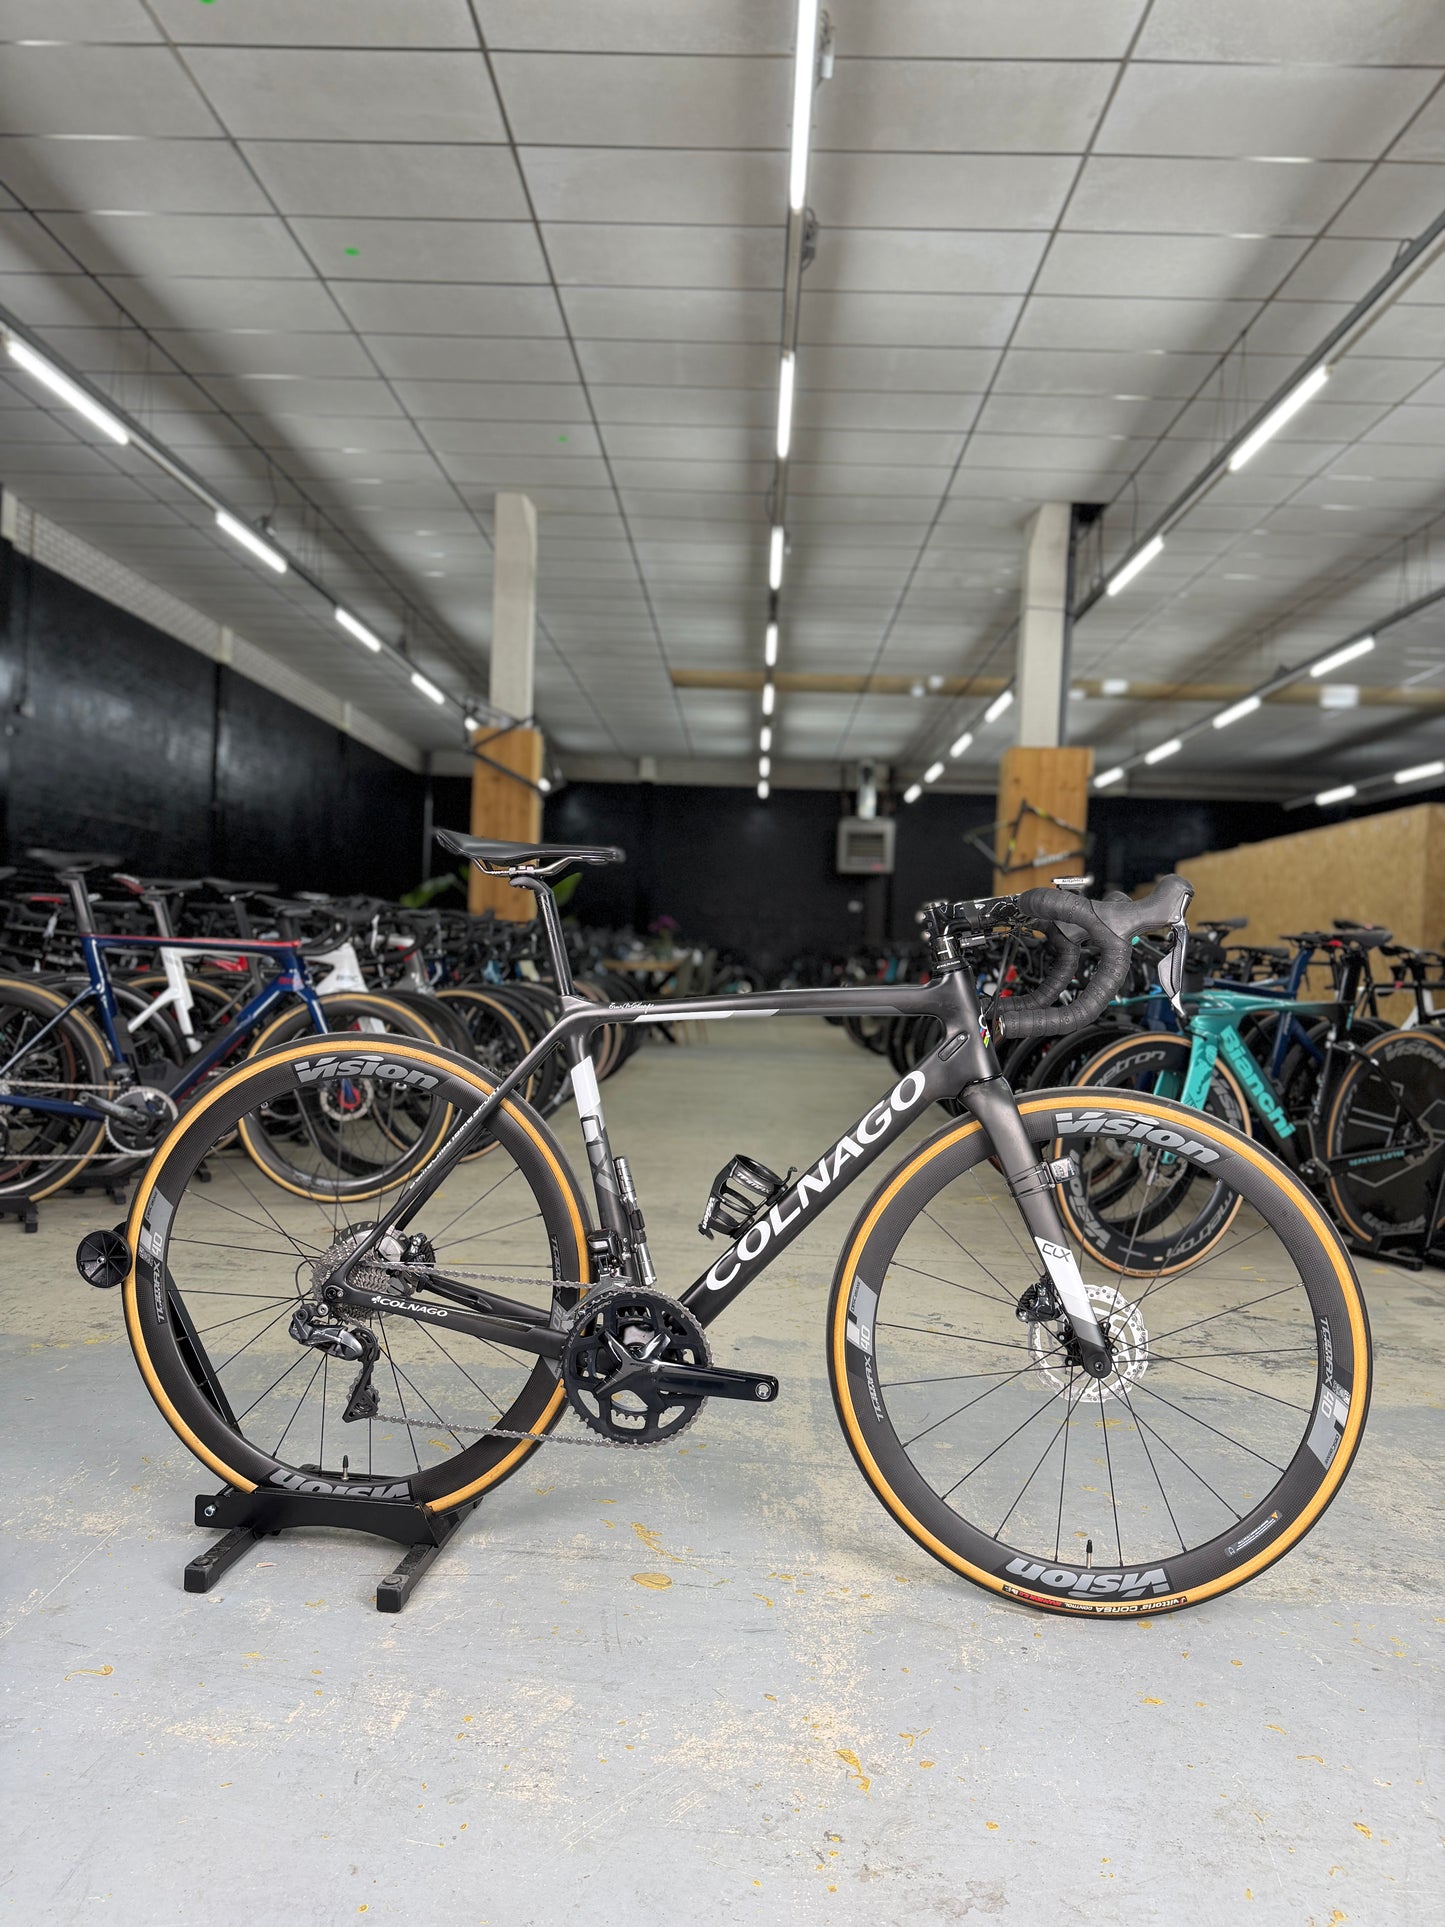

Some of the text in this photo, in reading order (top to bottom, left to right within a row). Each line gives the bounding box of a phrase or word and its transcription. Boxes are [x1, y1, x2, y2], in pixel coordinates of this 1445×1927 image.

[294, 1055, 439, 1090] Vision
[1221, 1025, 1296, 1138] Bianchi
[1056, 1112, 1221, 1164] Vision
[705, 1070, 926, 1291] COLNAGO
[151, 1231, 163, 1256] 40
[1042, 1243, 1071, 1262] CLX
[379, 1298, 448, 1317] COLNAGO
[860, 1324, 871, 1350] 40
[1321, 1390, 1335, 1419] 40
[1005, 1557, 1171, 1598] Vision
[1096, 1605, 1138, 1613] CORSA
